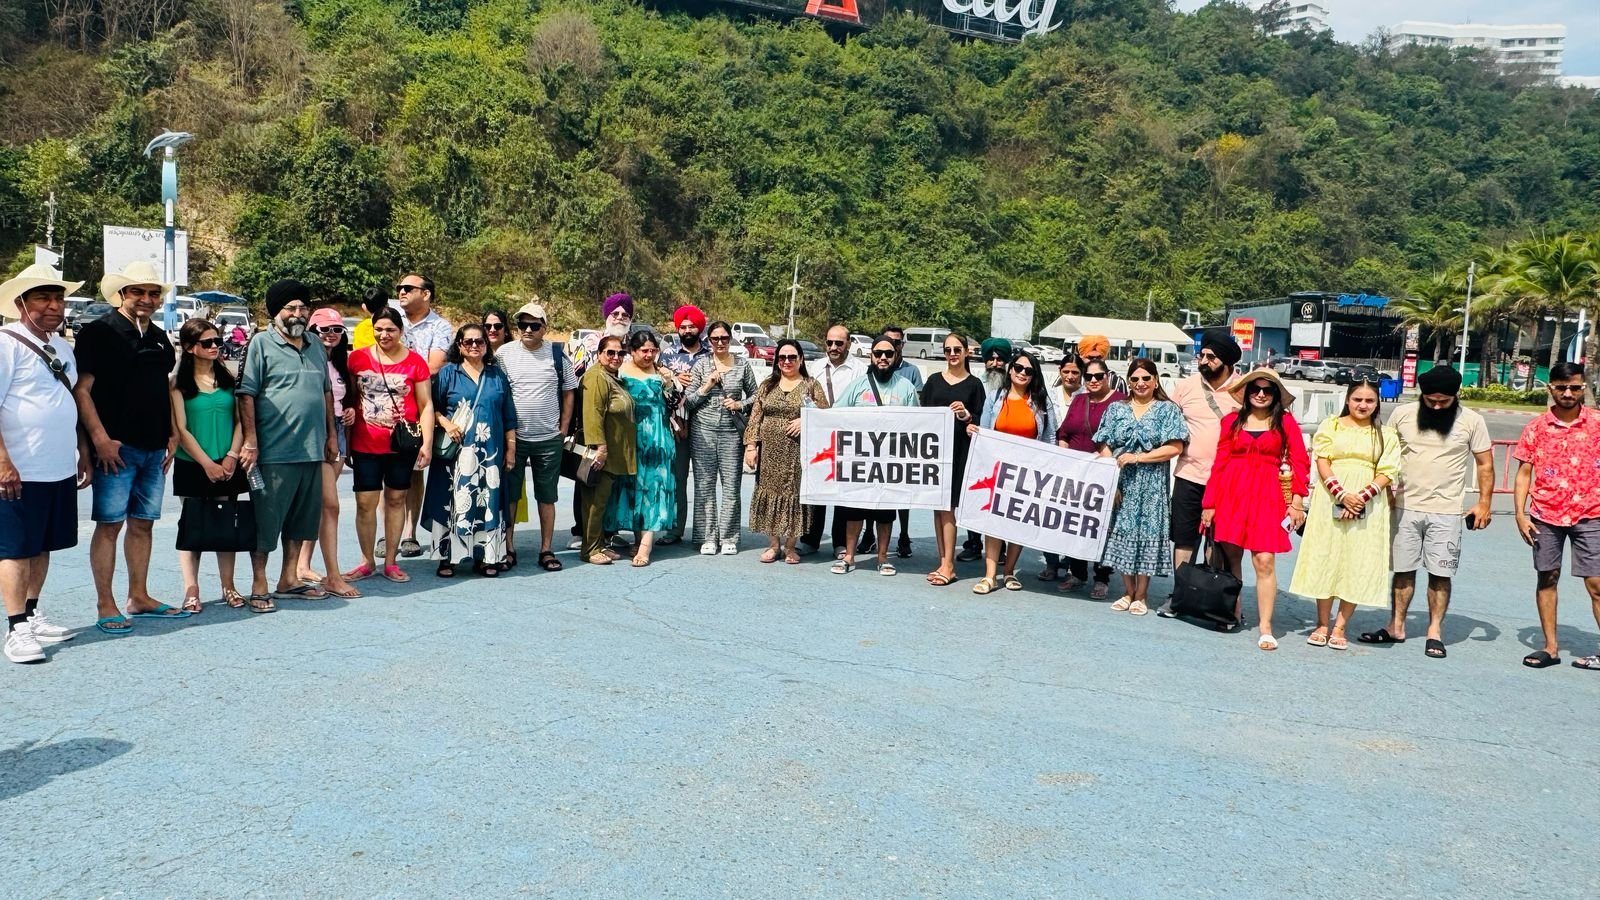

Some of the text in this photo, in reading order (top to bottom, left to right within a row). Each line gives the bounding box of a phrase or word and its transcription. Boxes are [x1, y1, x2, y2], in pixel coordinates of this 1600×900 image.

[837, 431, 939, 459] FLYING
[836, 461, 940, 485] LEADER
[997, 462, 1105, 512] FLYING
[991, 493, 1100, 539] LEADER
